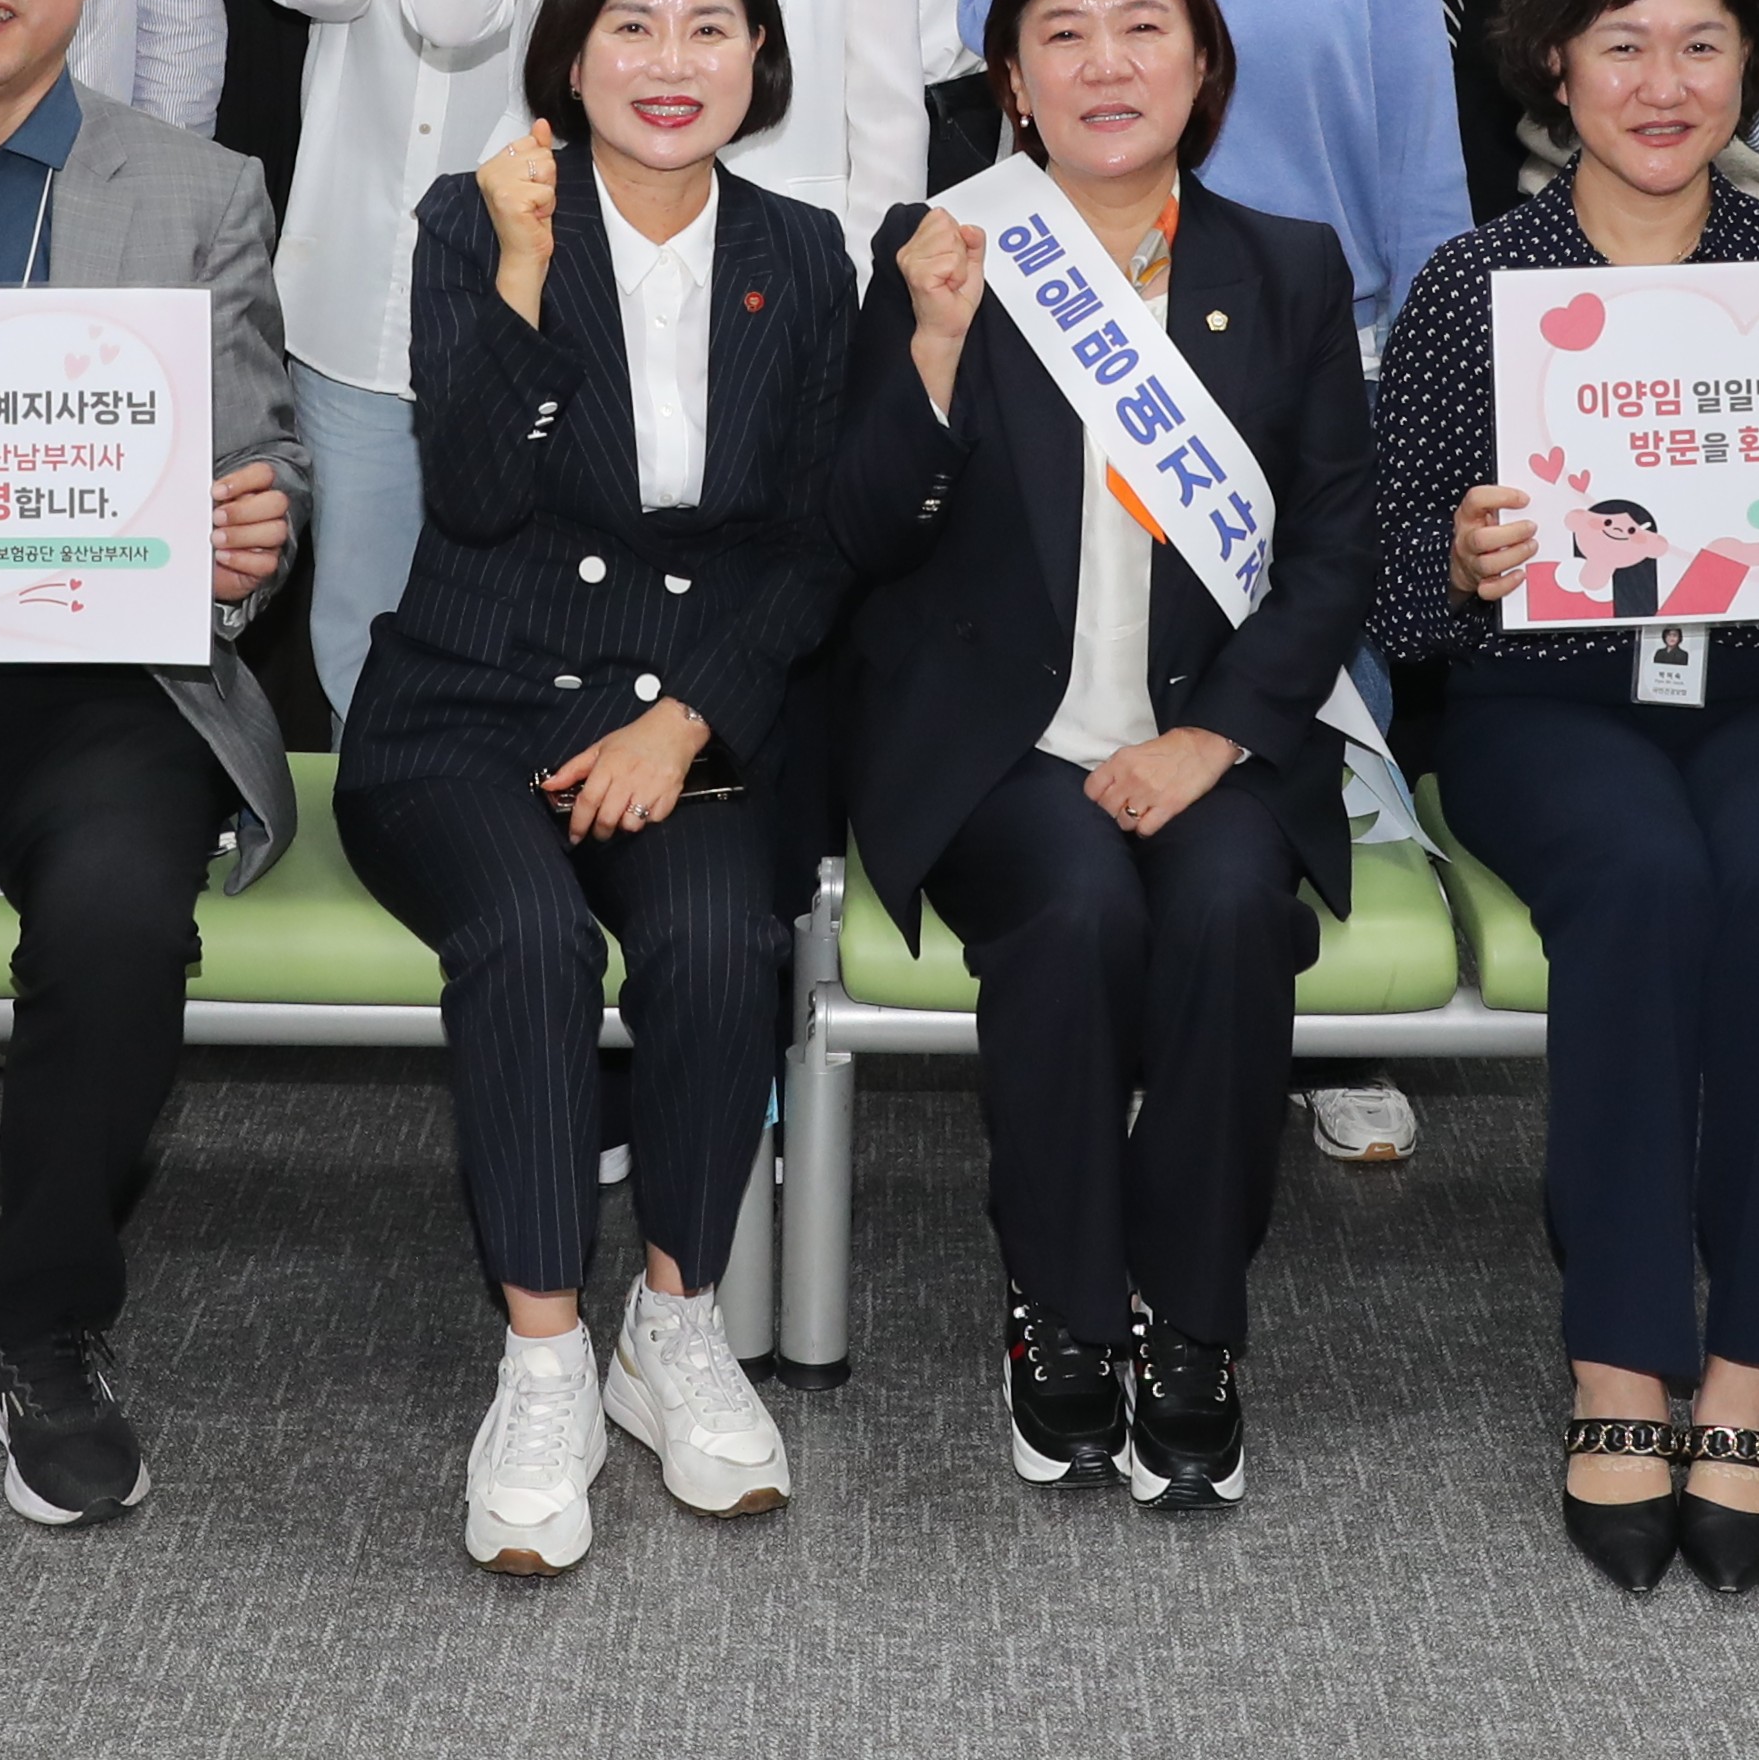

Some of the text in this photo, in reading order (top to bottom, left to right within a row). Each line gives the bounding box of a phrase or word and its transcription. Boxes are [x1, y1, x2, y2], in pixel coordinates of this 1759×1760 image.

[1575, 377, 1682, 418] 이양임
[1628, 428, 1730, 468] 방문을
[59, 543, 149, 564] 울산남부지사
